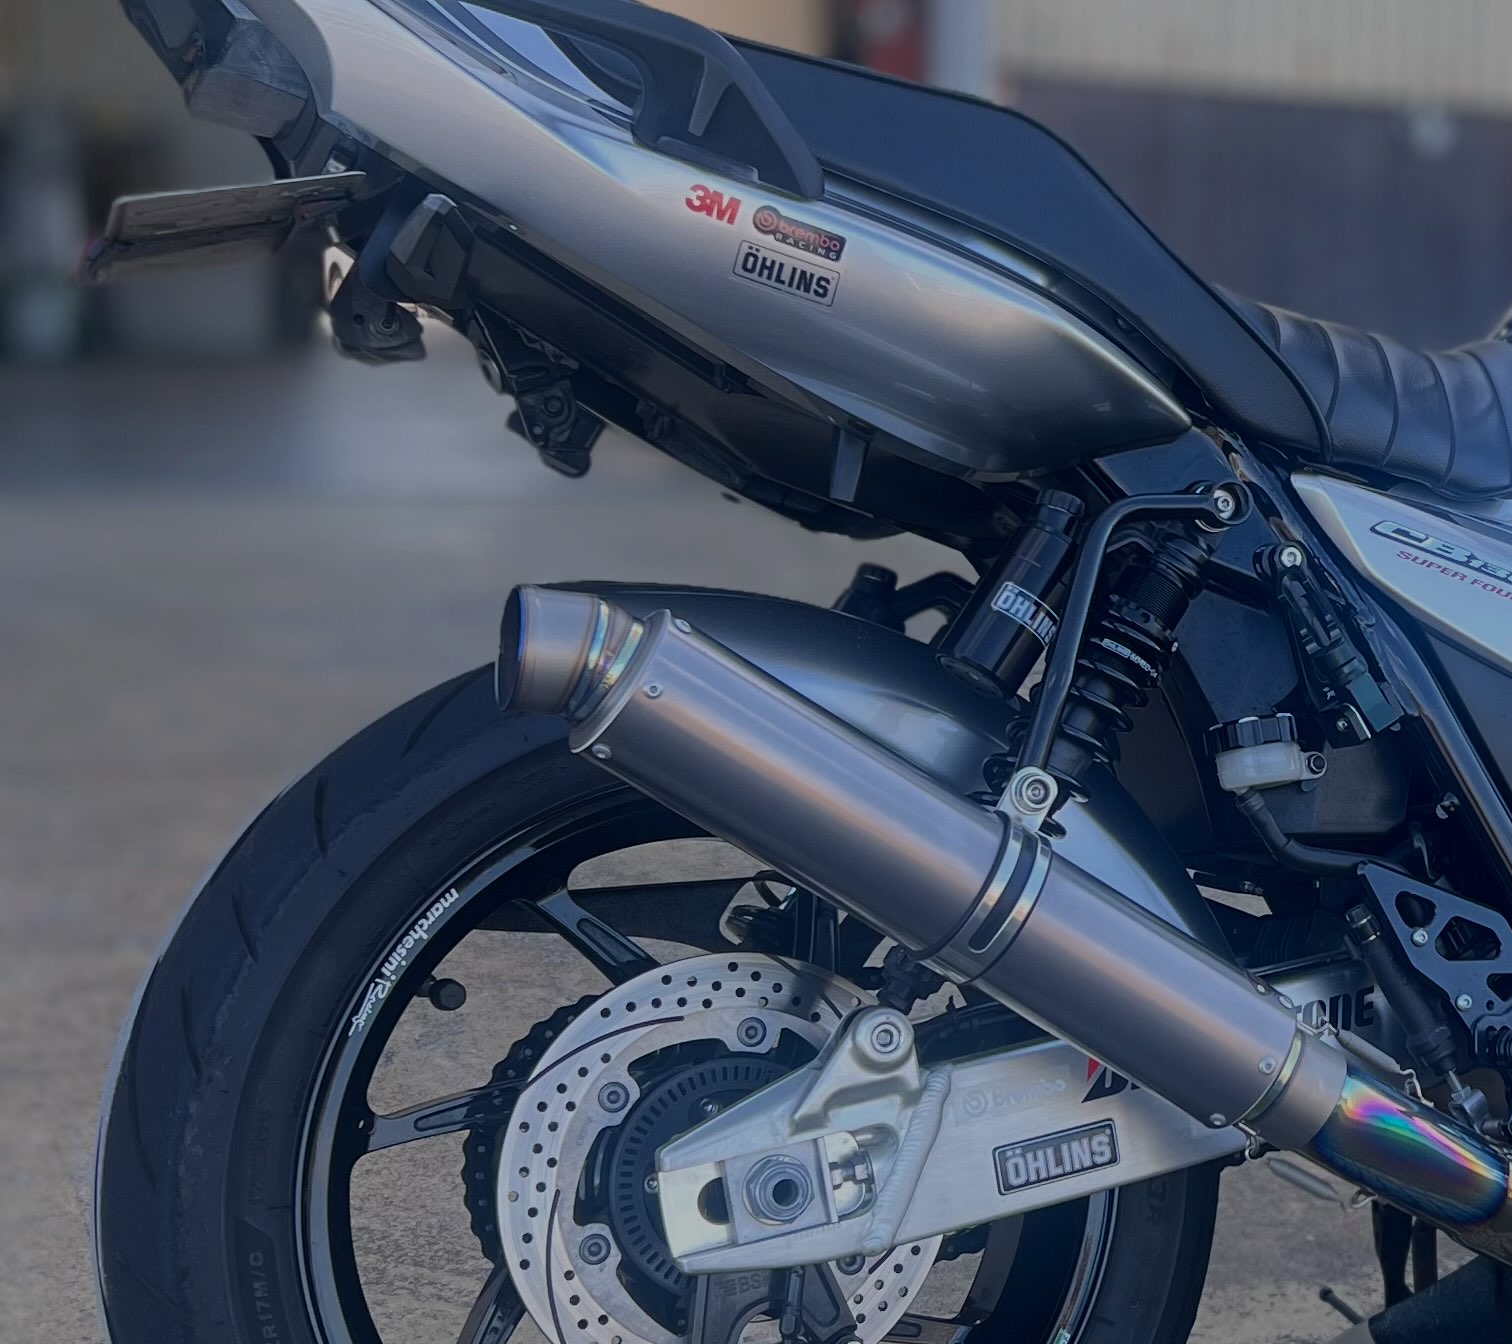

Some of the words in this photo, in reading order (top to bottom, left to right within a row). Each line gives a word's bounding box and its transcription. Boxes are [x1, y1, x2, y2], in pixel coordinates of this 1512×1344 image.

[685, 184, 742, 226] 3M
[775, 232, 837, 260] RACING
[778, 218, 840, 252] brembo
[741, 245, 831, 298] ÖHLINS
[1396, 550, 1468, 582] SUPER
[380, 887, 460, 981] marchesini
[1005, 1132, 1113, 1187] ÖHLINS
